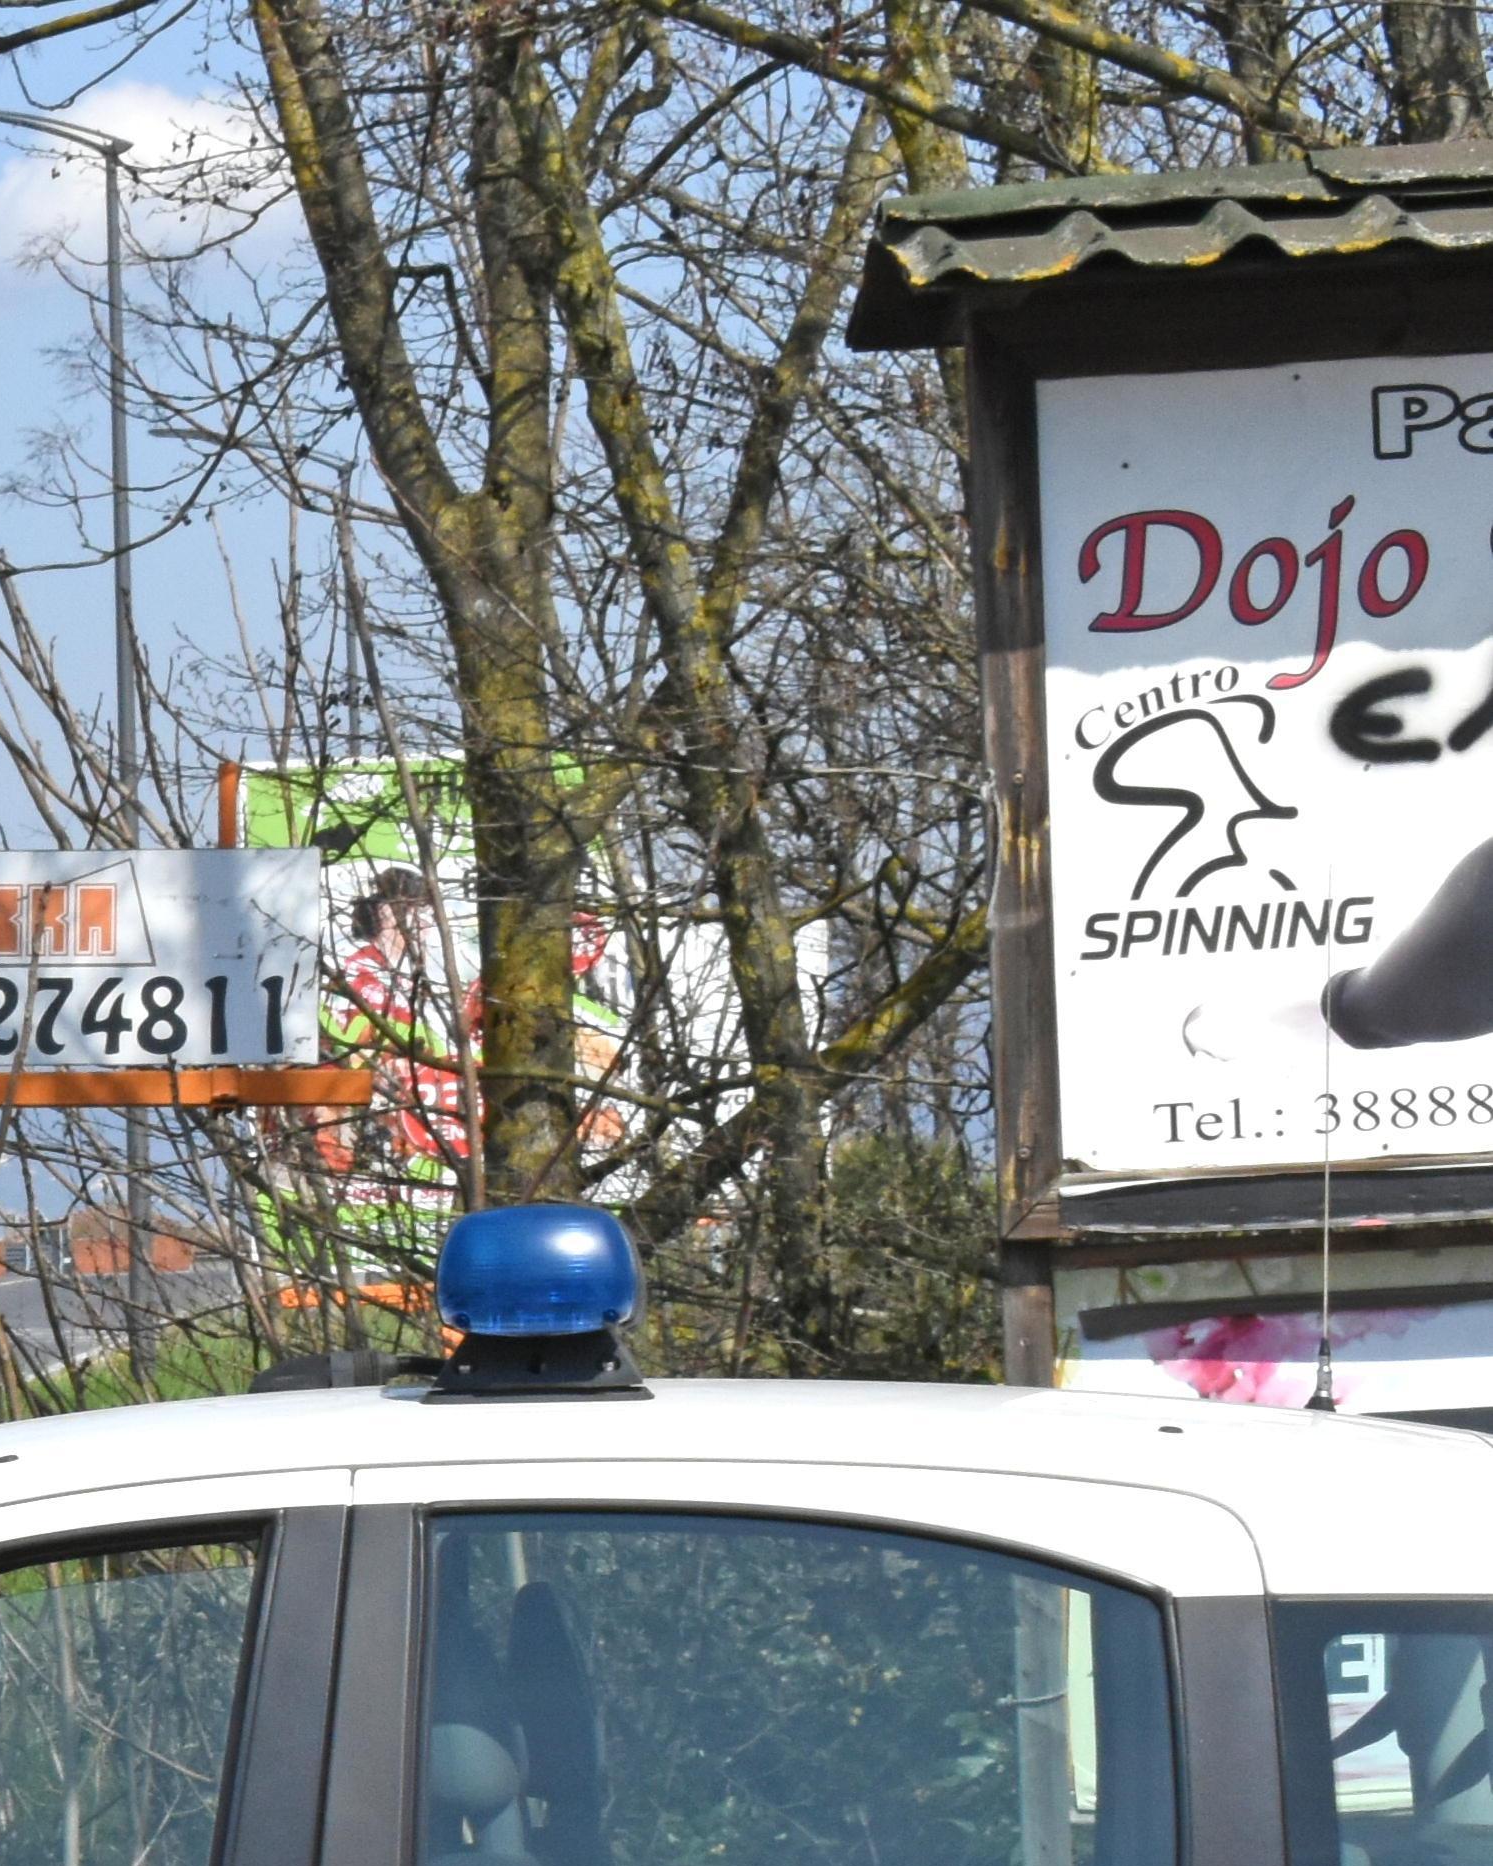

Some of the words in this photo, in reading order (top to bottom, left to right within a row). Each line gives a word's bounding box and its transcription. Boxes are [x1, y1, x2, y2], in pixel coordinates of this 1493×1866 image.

[1078, 495, 1430, 690] Dojo
[1075, 665, 1239, 751] Centro
[1081, 897, 1374, 961] SPINNING
[1153, 1098, 1285, 1144] Tel.:
